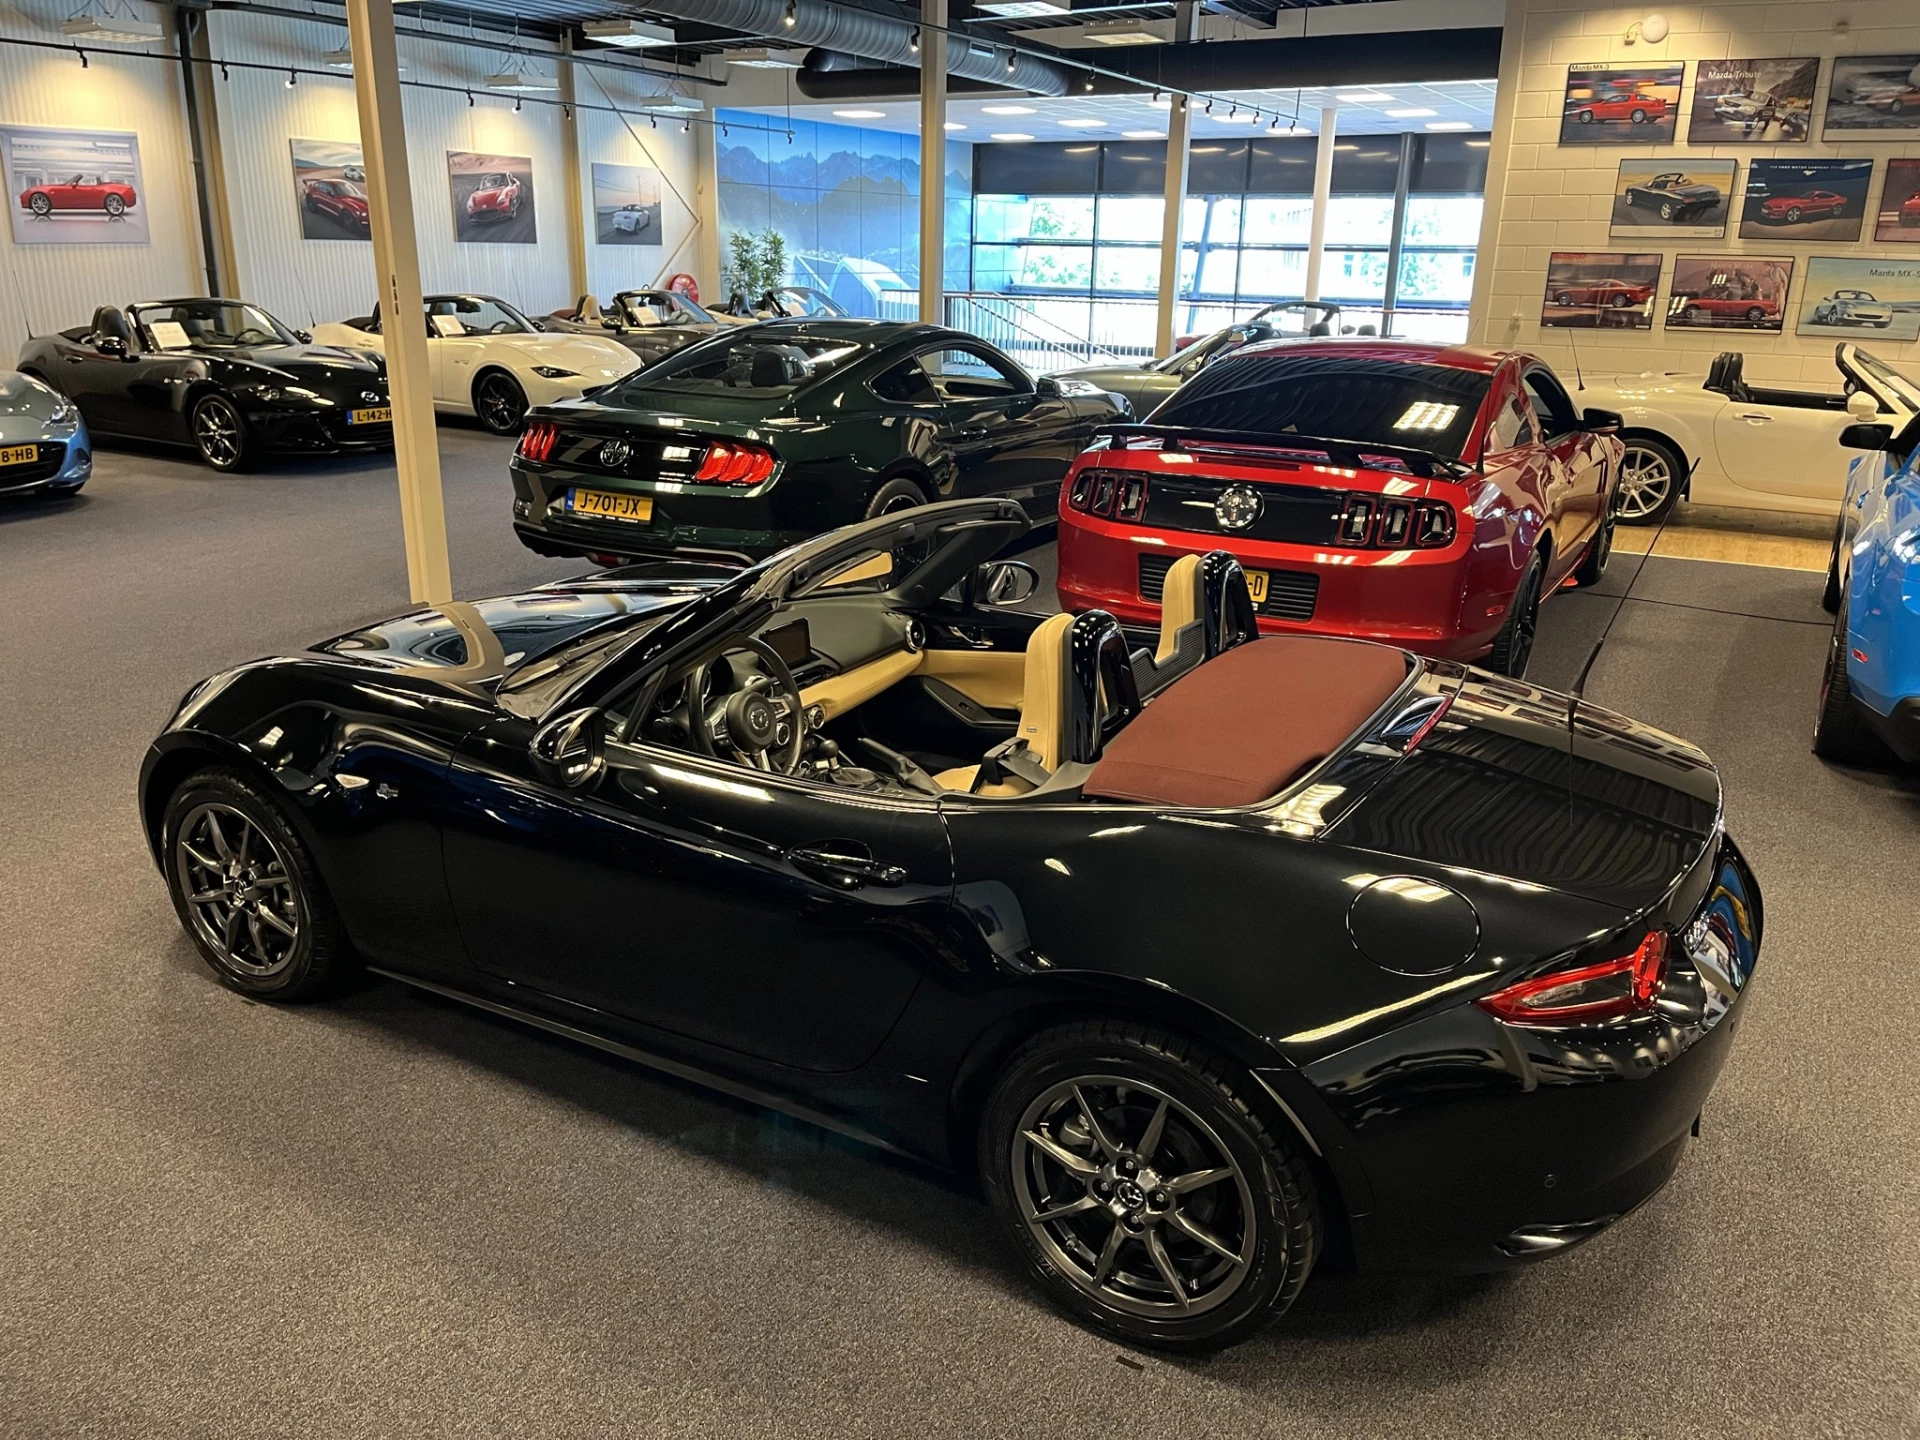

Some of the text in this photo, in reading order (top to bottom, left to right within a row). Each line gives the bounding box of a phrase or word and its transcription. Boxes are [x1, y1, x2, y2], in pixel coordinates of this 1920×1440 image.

[1708, 70, 1761, 79] Mazda Tribute
[1870, 269, 1895, 277] Mazda
[580, 492, 641, 516] J-701-JX
